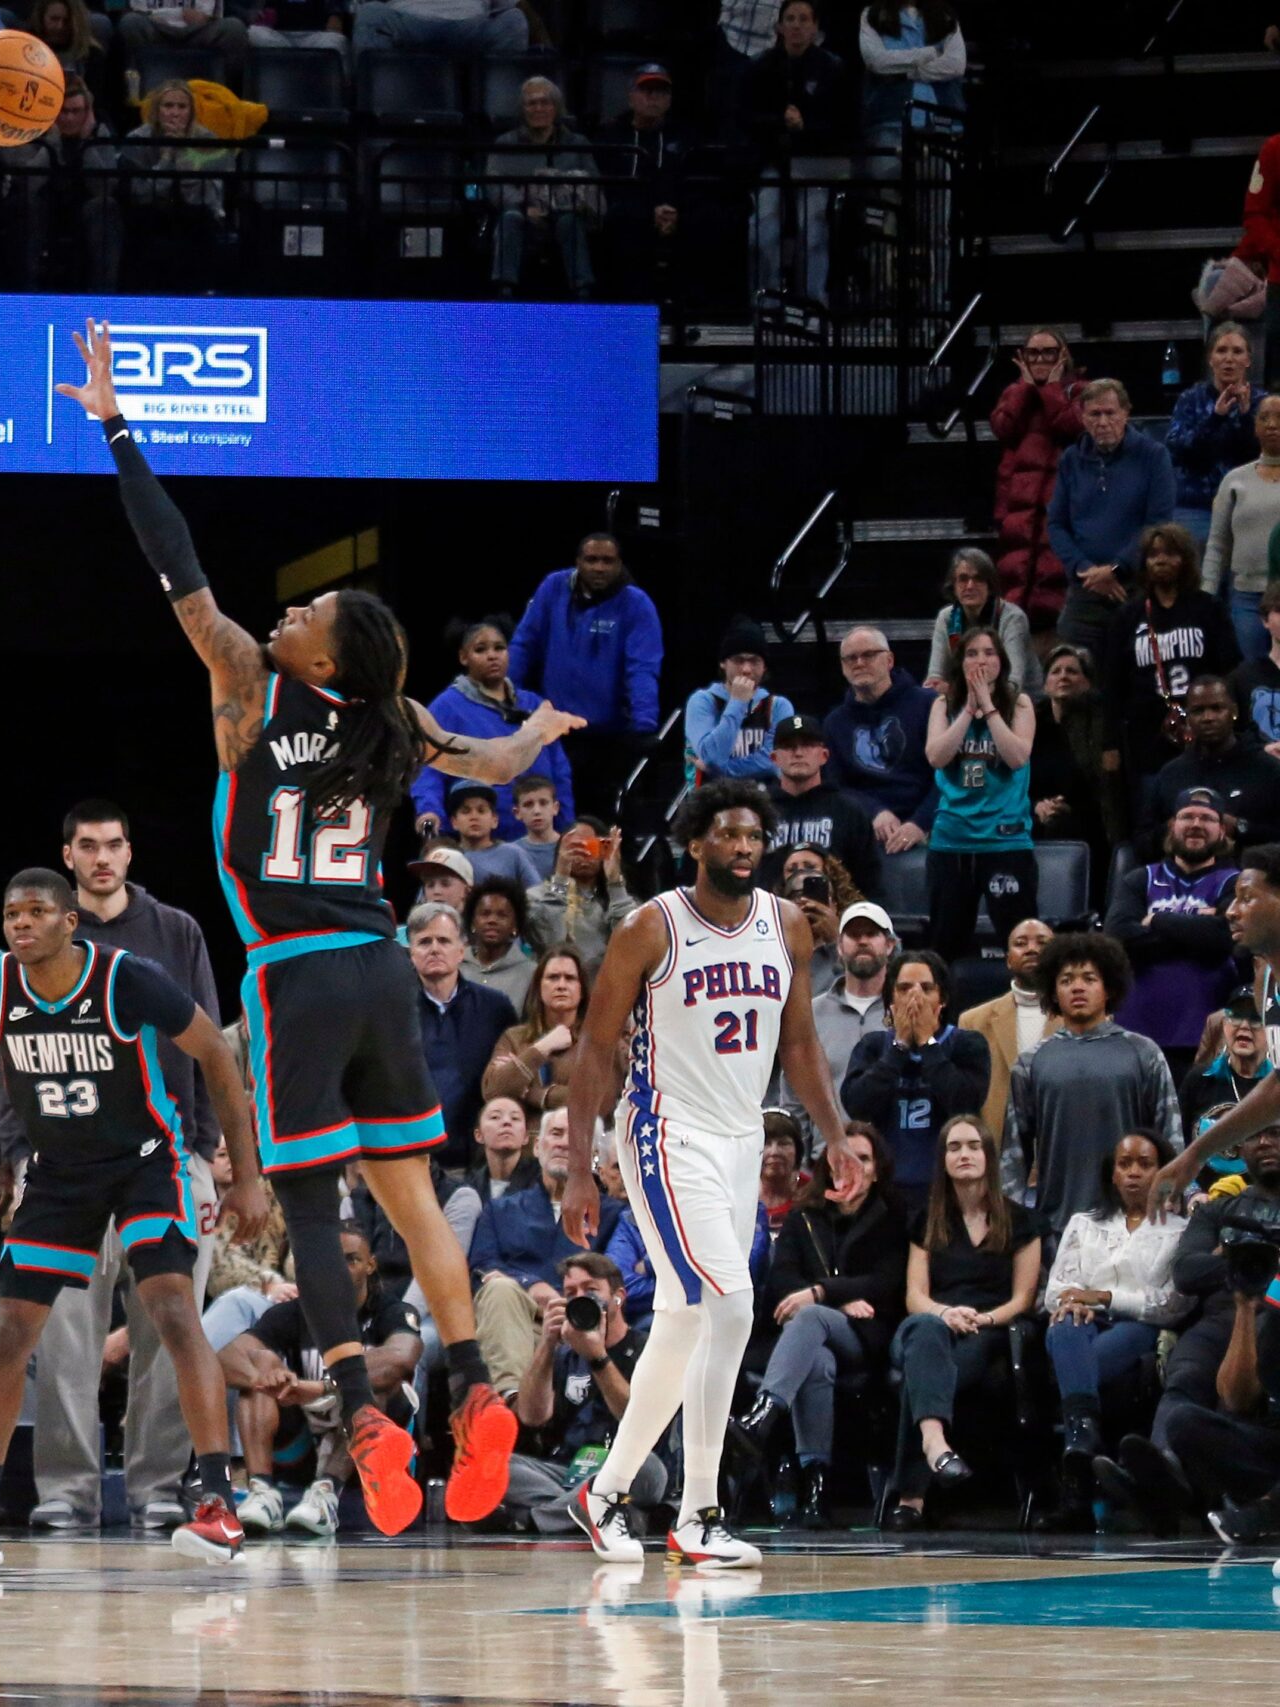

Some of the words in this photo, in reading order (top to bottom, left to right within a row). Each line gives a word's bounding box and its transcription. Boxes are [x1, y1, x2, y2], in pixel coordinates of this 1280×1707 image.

[110, 341, 253, 388] BRS
[144, 402, 166, 414] BIG
[170, 403, 208, 415] RIVER
[214, 403, 253, 416] STEEL
[151, 430, 189, 444] Steel
[191, 432, 252, 447] company
[260, 785, 375, 887] 12
[682, 961, 782, 1008] PHILA
[713, 1008, 759, 1055] 21
[6, 1032, 115, 1074] MEMPHIS
[35, 1079, 100, 1118] 23
[898, 1098, 932, 1130] 12
